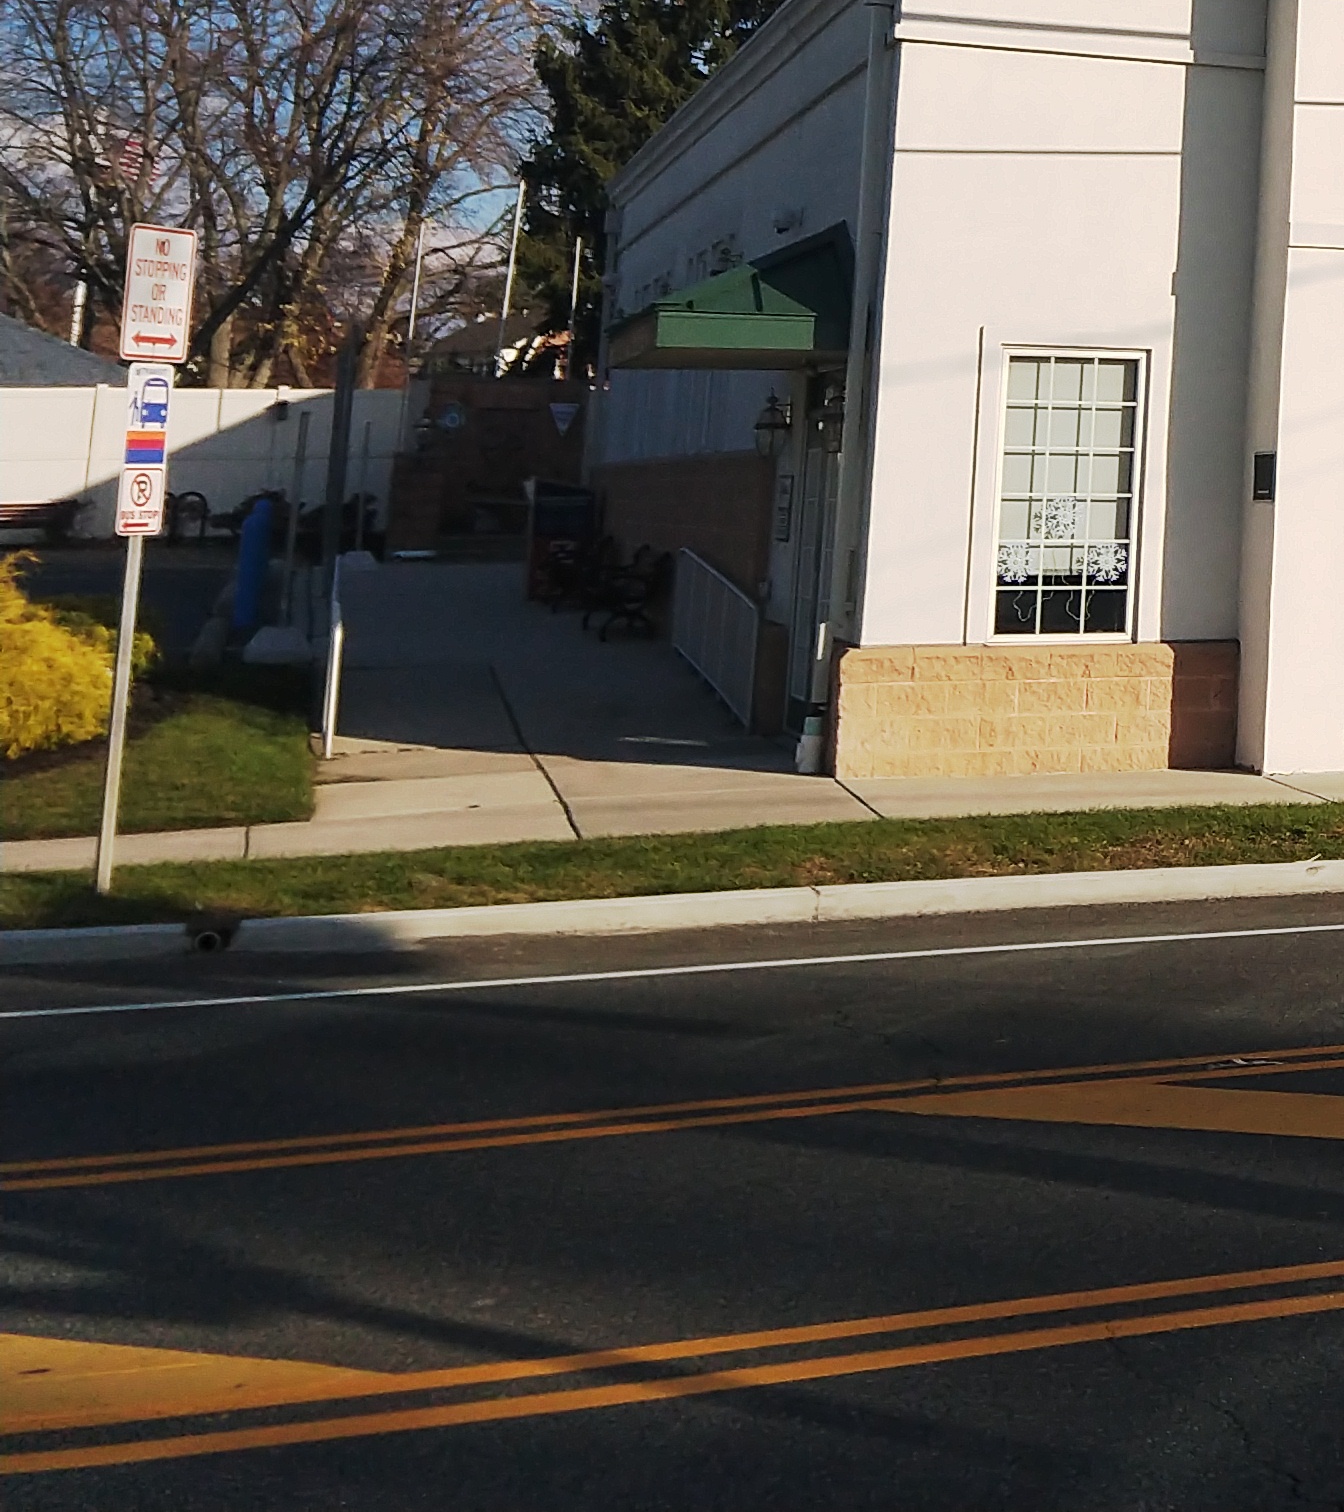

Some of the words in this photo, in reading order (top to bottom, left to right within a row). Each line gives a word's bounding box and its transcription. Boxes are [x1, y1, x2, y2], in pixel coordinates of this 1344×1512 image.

[155, 238, 171, 257] NO
[135, 258, 187, 281] STOPPING
[151, 283, 167, 301] OR
[131, 304, 183, 326] STANDING
[120, 510, 136, 520] BUS
[139, 510, 160, 520] STOP
